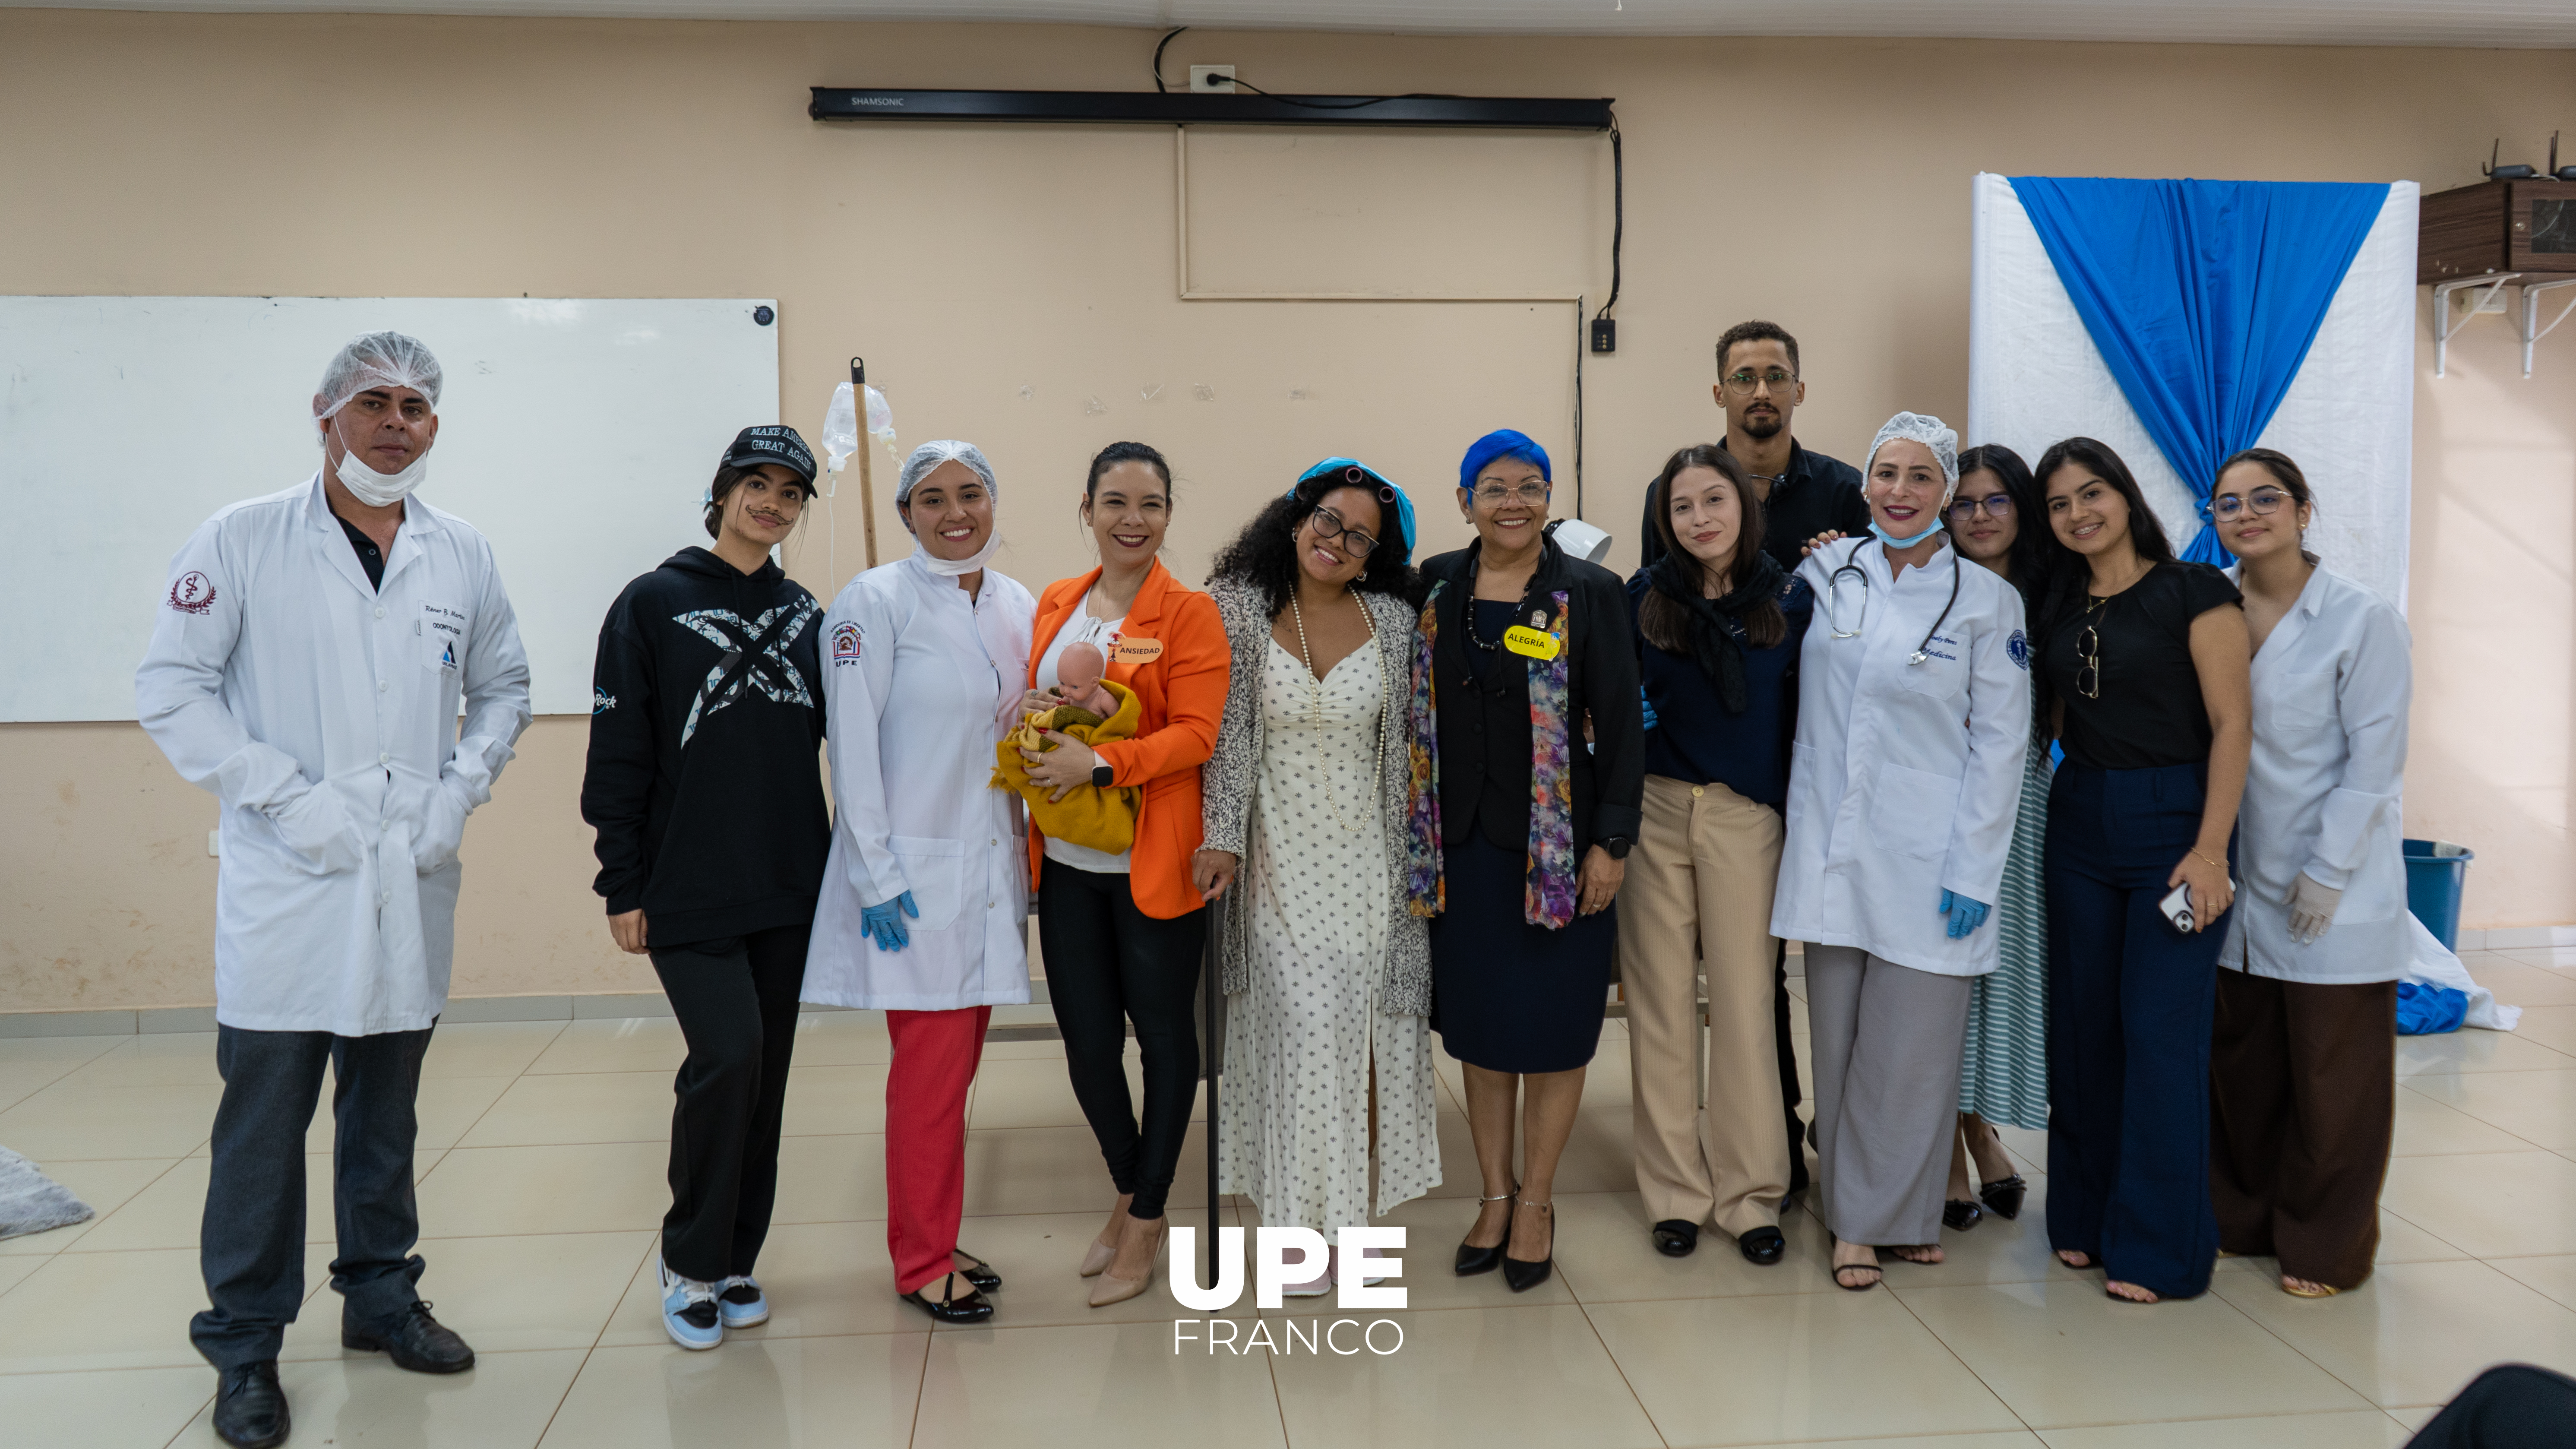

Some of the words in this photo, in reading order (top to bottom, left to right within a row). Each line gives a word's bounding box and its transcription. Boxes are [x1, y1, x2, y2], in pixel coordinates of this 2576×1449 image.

[851, 97, 904, 106] SHAMSONIC
[750, 427, 781, 436] MAKE
[782, 428, 814, 460] AMERICA
[752, 440, 785, 453] GREAT
[787, 447, 811, 471] AGAIN
[1508, 633, 1544, 648] ALEGRÍA
[594, 693, 616, 708] Rock
